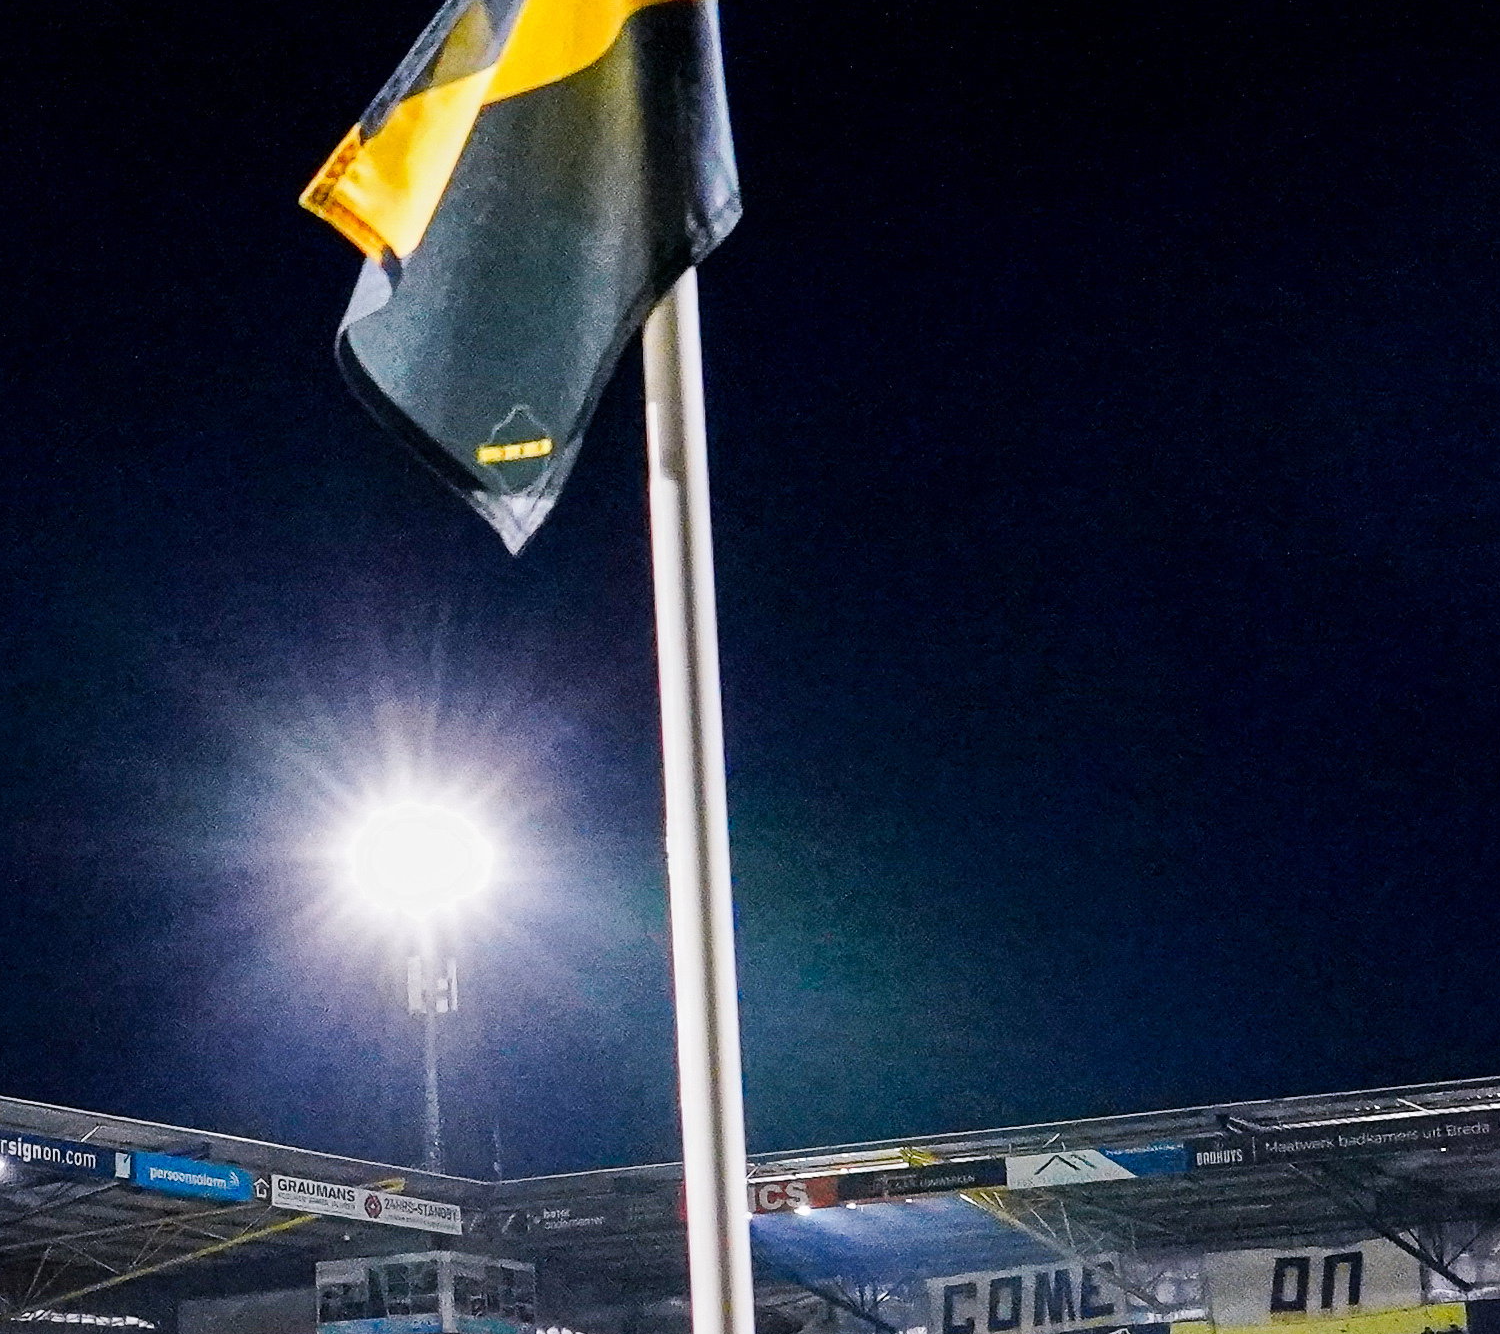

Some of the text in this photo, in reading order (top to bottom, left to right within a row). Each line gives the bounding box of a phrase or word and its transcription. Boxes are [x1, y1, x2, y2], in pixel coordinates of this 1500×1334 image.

[1423, 1127, 1442, 1142] uit
[1446, 1120, 1491, 1137] Breda
[277, 1177, 356, 1203] GRAUMANS
